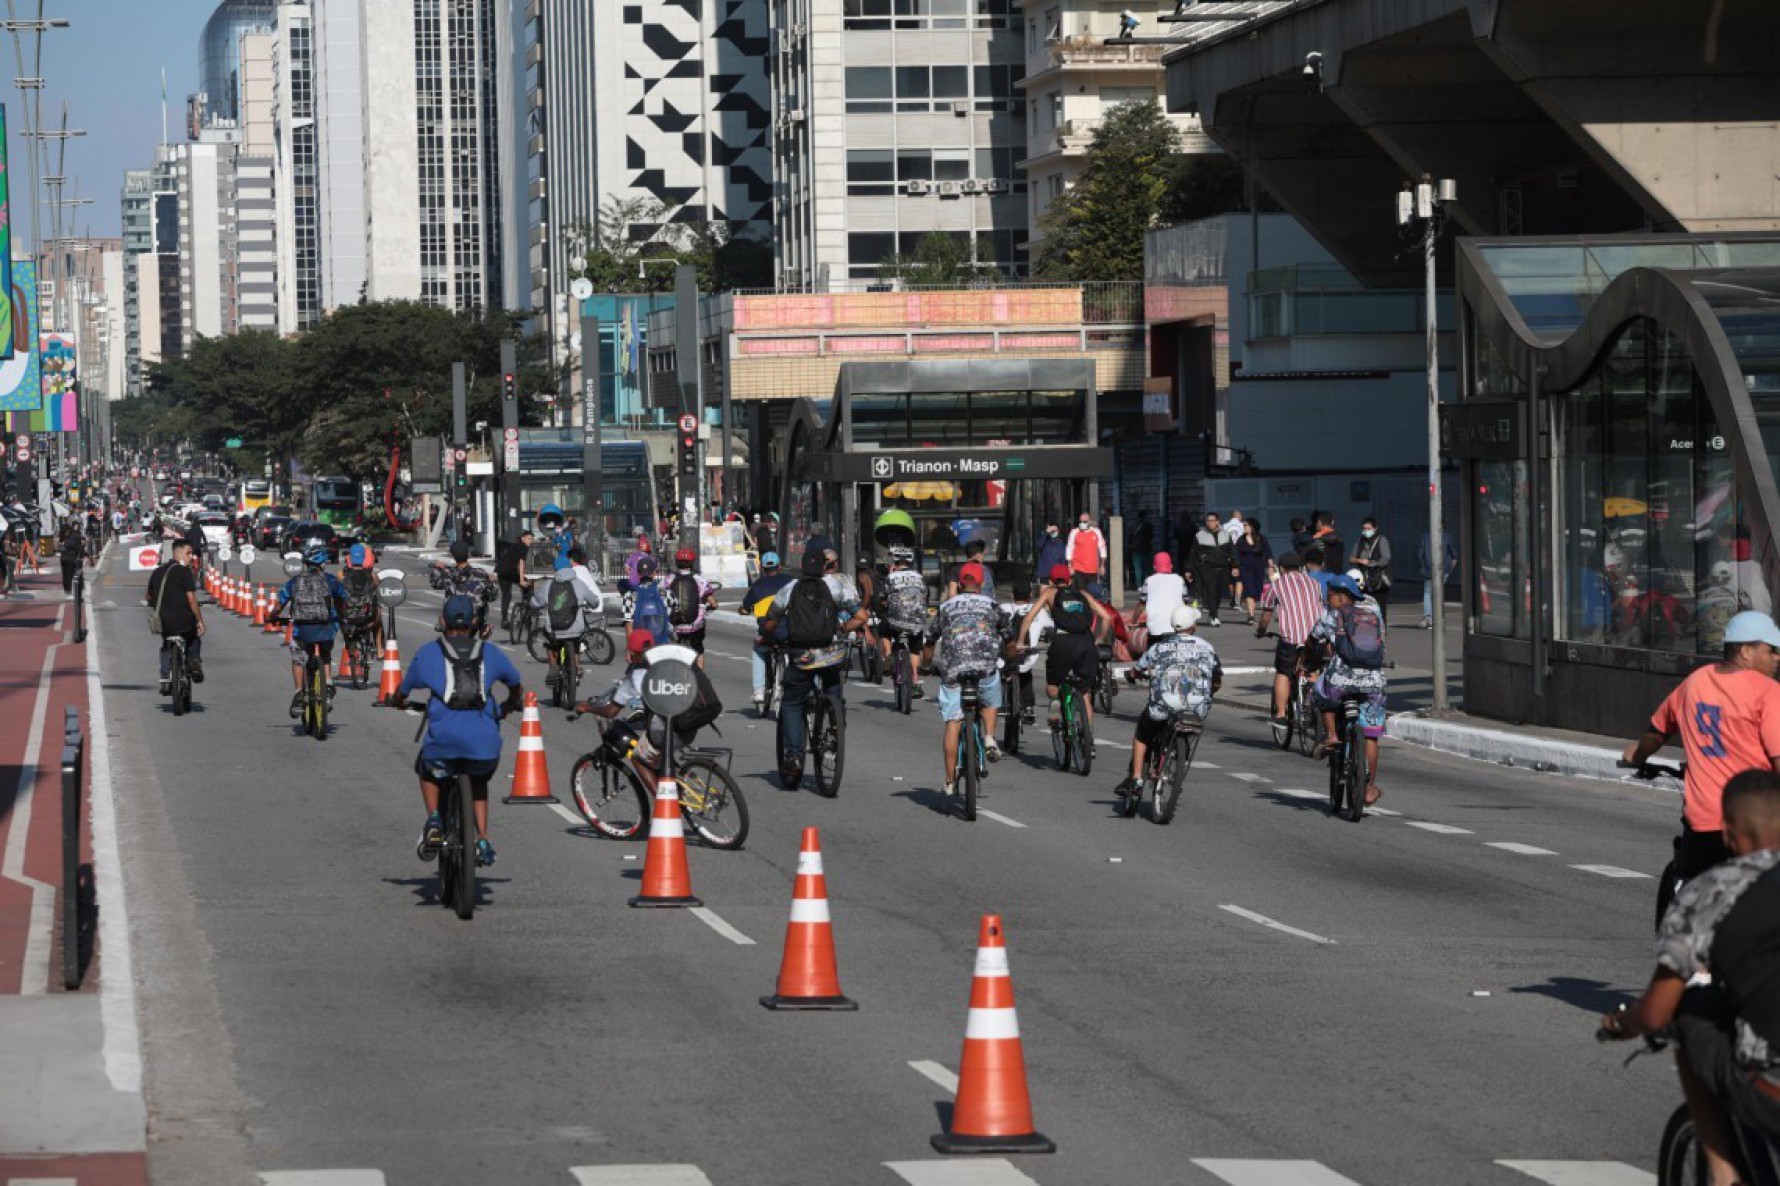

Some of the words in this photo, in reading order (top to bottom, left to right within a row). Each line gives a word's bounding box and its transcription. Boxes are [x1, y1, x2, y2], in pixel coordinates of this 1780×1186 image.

[585, 378, 596, 432] Pamplona
[898, 459, 952, 474] Trianon
[959, 458, 1000, 475] Masp
[380, 587, 402, 597] Uber
[648, 678, 692, 696] Uber
[1695, 701, 1728, 758] 9
